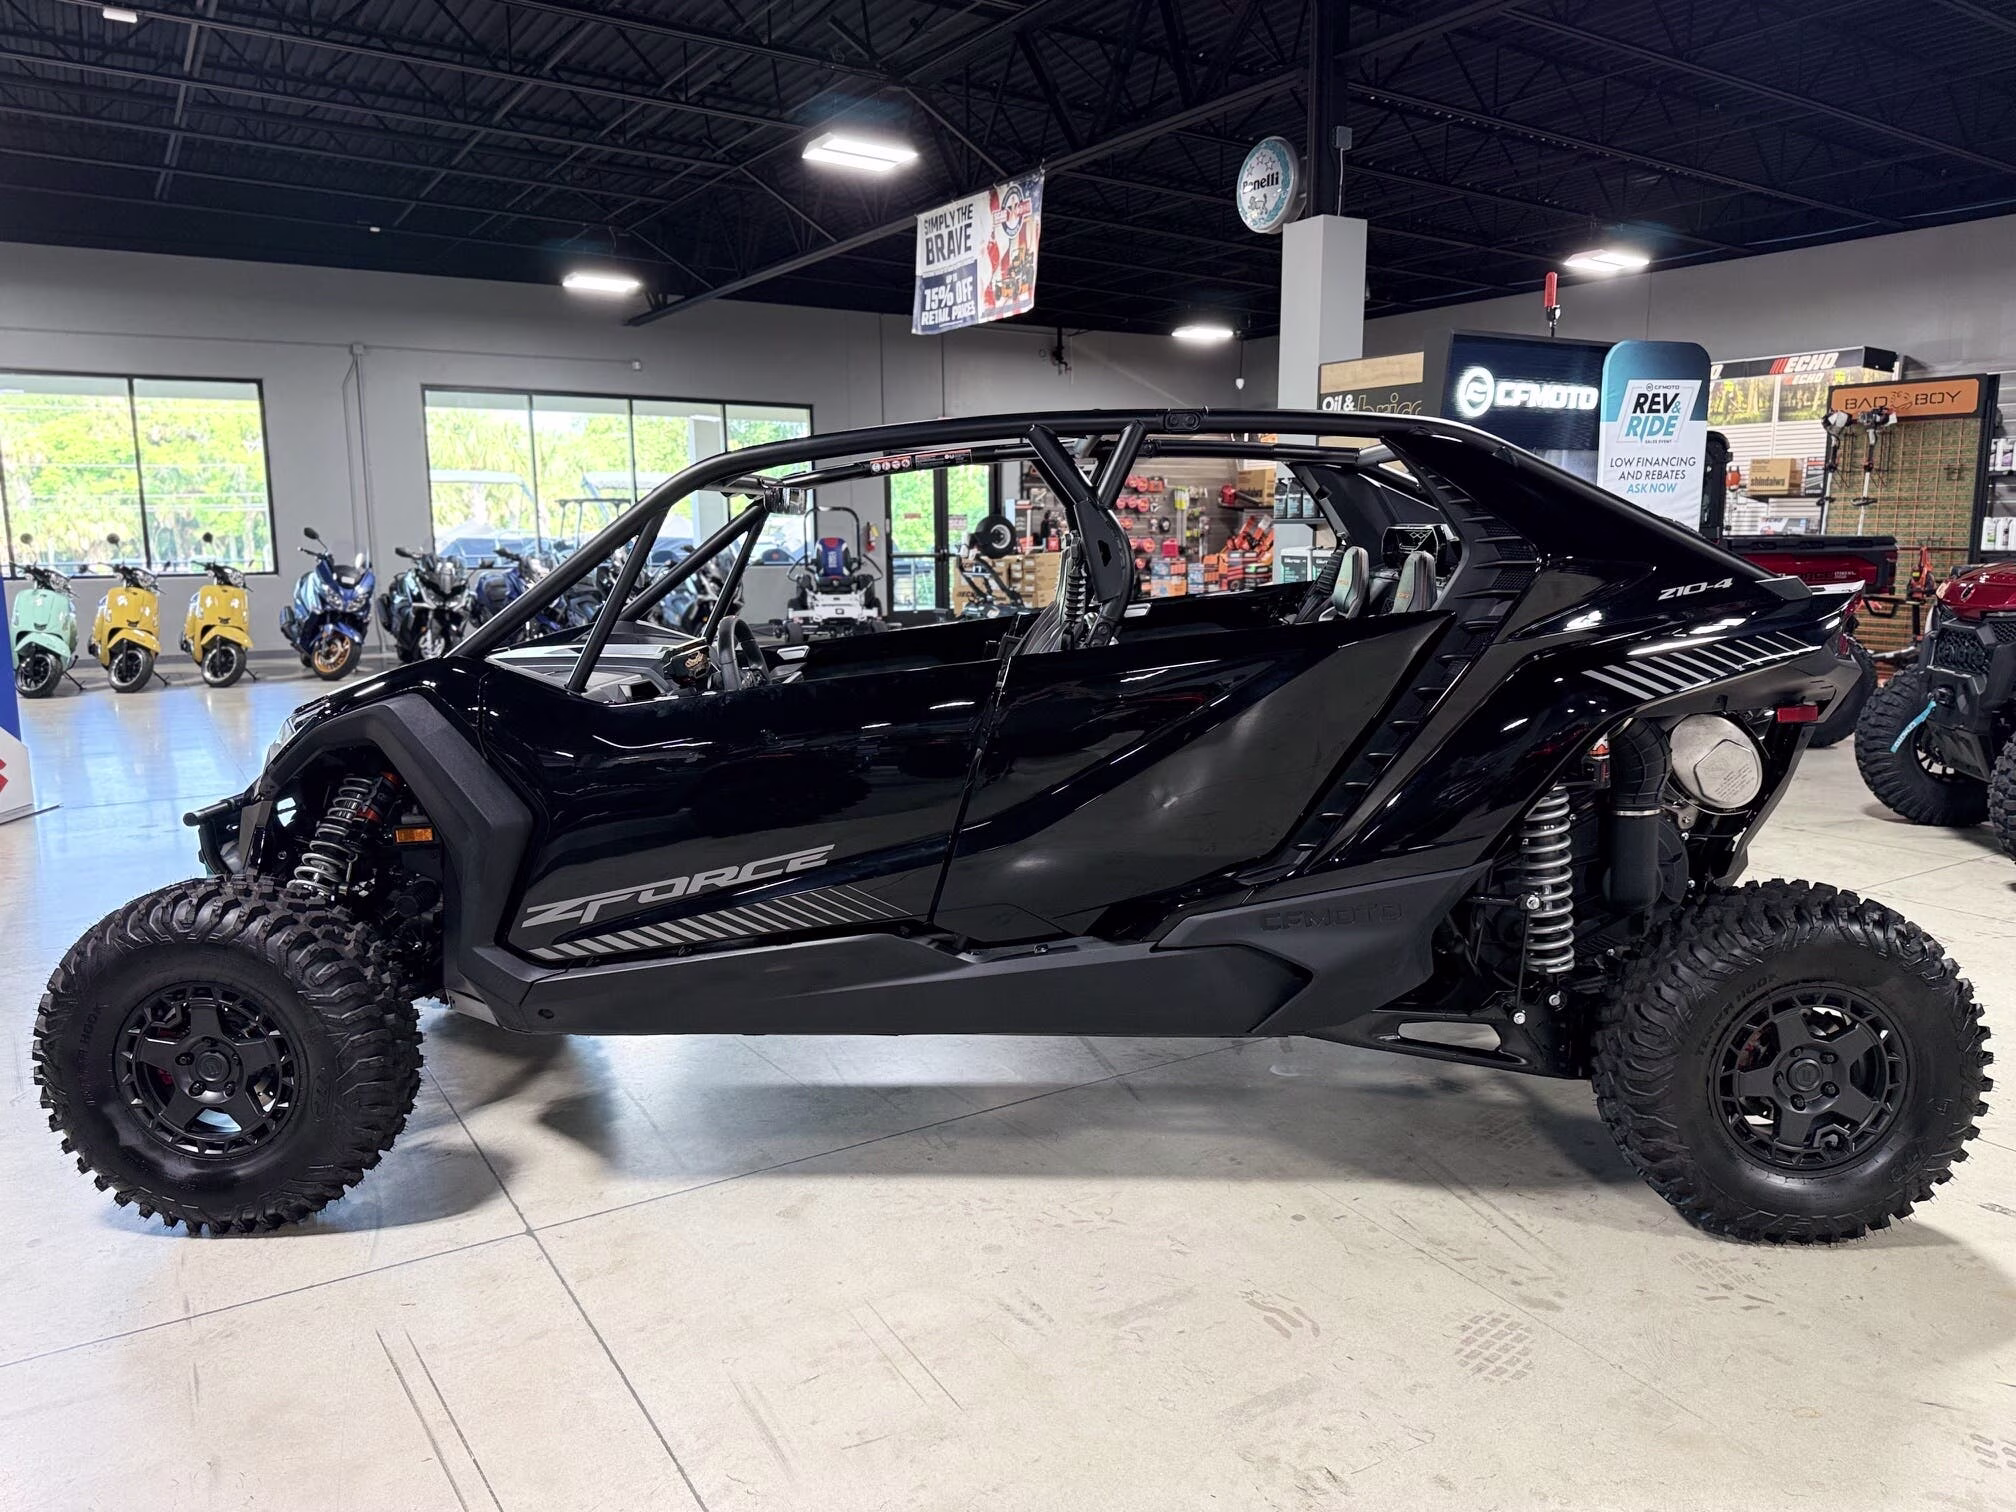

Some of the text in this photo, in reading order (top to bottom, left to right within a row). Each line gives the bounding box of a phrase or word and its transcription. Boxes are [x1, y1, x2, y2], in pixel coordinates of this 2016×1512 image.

[1243, 172, 1279, 194] Bnelli
[924, 209, 956, 236] SIMPLY
[956, 203, 974, 221] THE
[925, 222, 973, 266] BRAVE
[924, 275, 973, 311] 15% OFF
[921, 306, 951, 326] RETAIL
[951, 300, 976, 321] PRICES
[1783, 352, 1839, 374] ECHO
[1791, 373, 1825, 384] ECHO
[1495, 379, 1599, 410] CFMOTO
[1845, 390, 1962, 410] BAD BOY
[1625, 415, 1680, 443] RIDE
[1610, 456, 1697, 468] LOW FINANCING
[1618, 469, 1686, 481] AND REBATES
[1626, 482, 1678, 494] ASK NOW
[520, 843, 836, 929] ZFORCE
